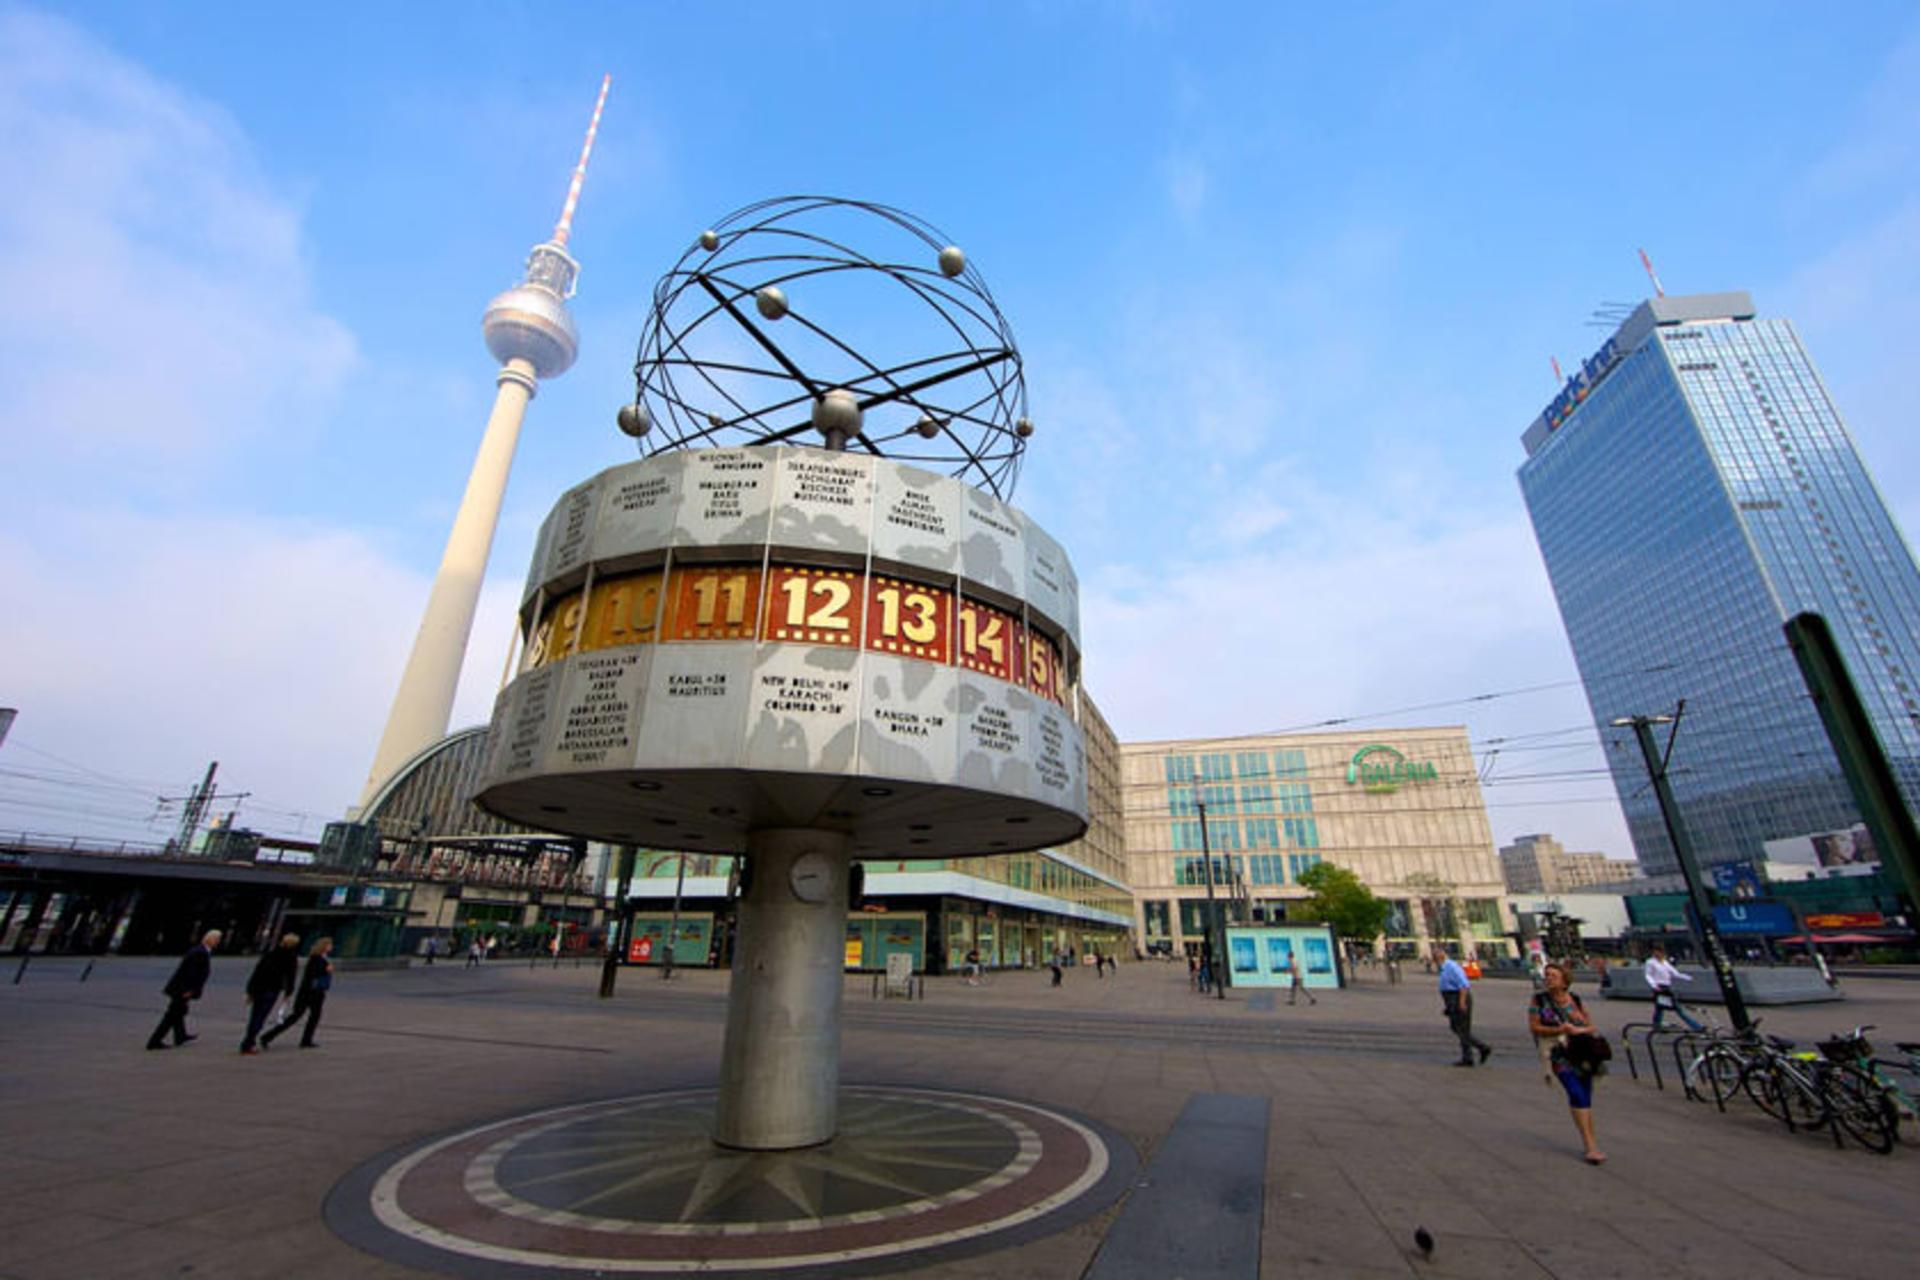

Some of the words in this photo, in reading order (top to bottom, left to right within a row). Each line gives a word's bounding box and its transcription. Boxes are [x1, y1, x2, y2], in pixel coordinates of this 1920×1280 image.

[693, 575, 747, 626] 11
[782, 577, 851, 629] 12
[877, 589, 937, 643] 13
[960, 608, 1005, 662] 14
[762, 676, 785, 685] NEW
[793, 678, 824, 688] DELHI
[1730, 905, 1748, 920] U
